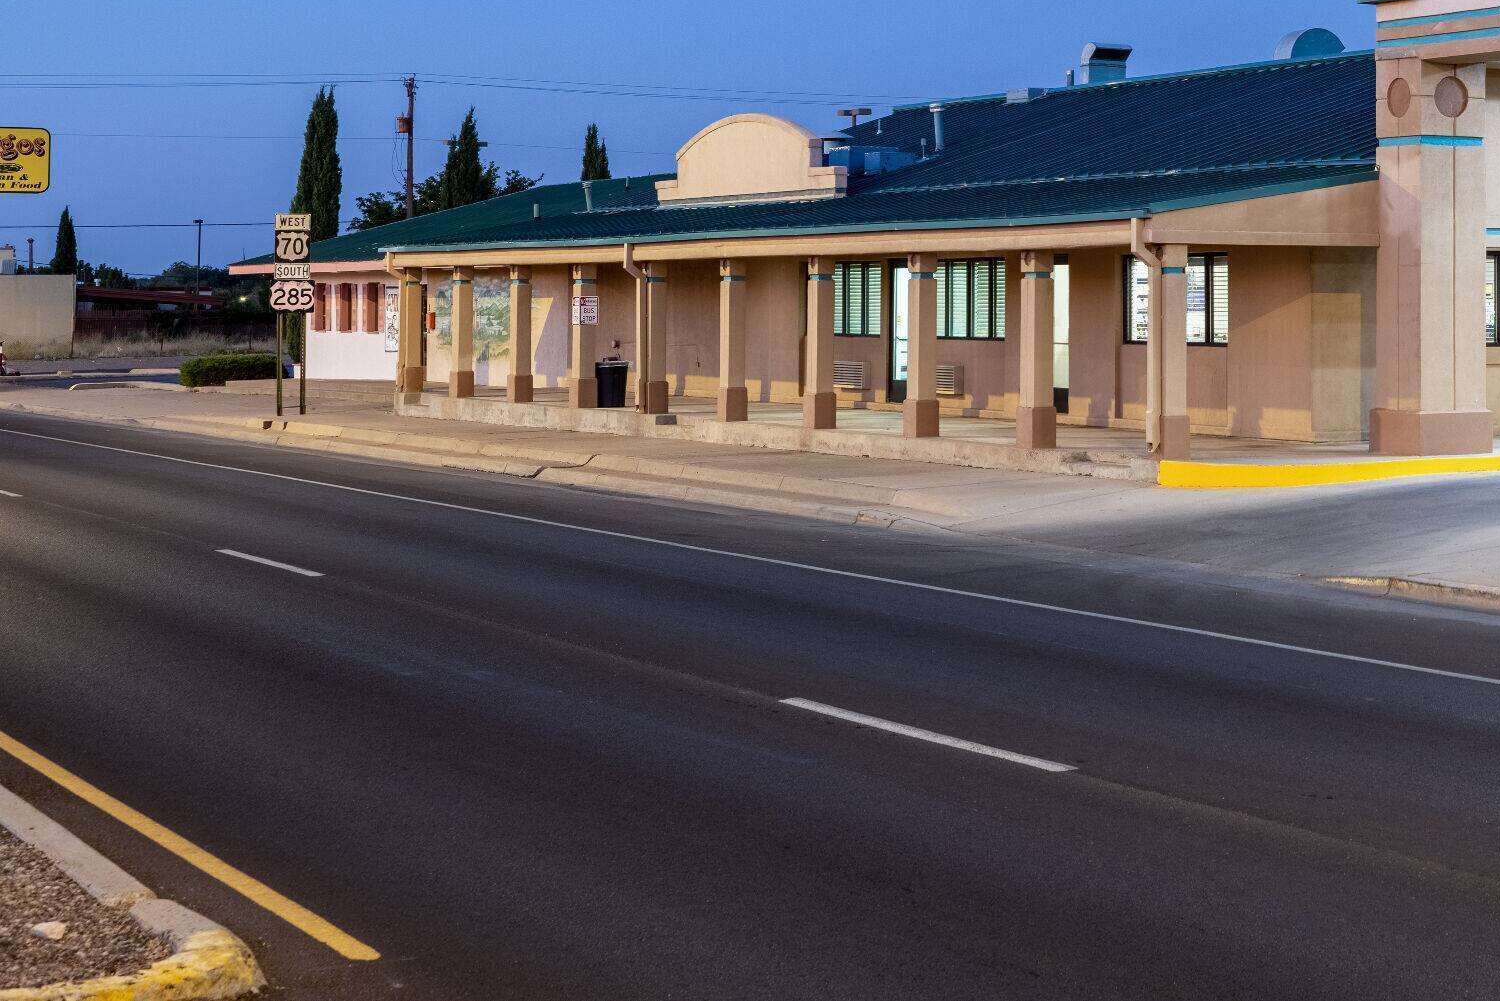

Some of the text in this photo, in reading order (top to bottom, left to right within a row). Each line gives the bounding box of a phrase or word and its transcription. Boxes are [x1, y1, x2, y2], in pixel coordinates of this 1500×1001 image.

[0, 134, 46, 160] gos
[280, 217, 306, 227] WEST
[281, 237, 304, 255] 70
[276, 266, 309, 277] SOUTH
[273, 288, 313, 306] 285
